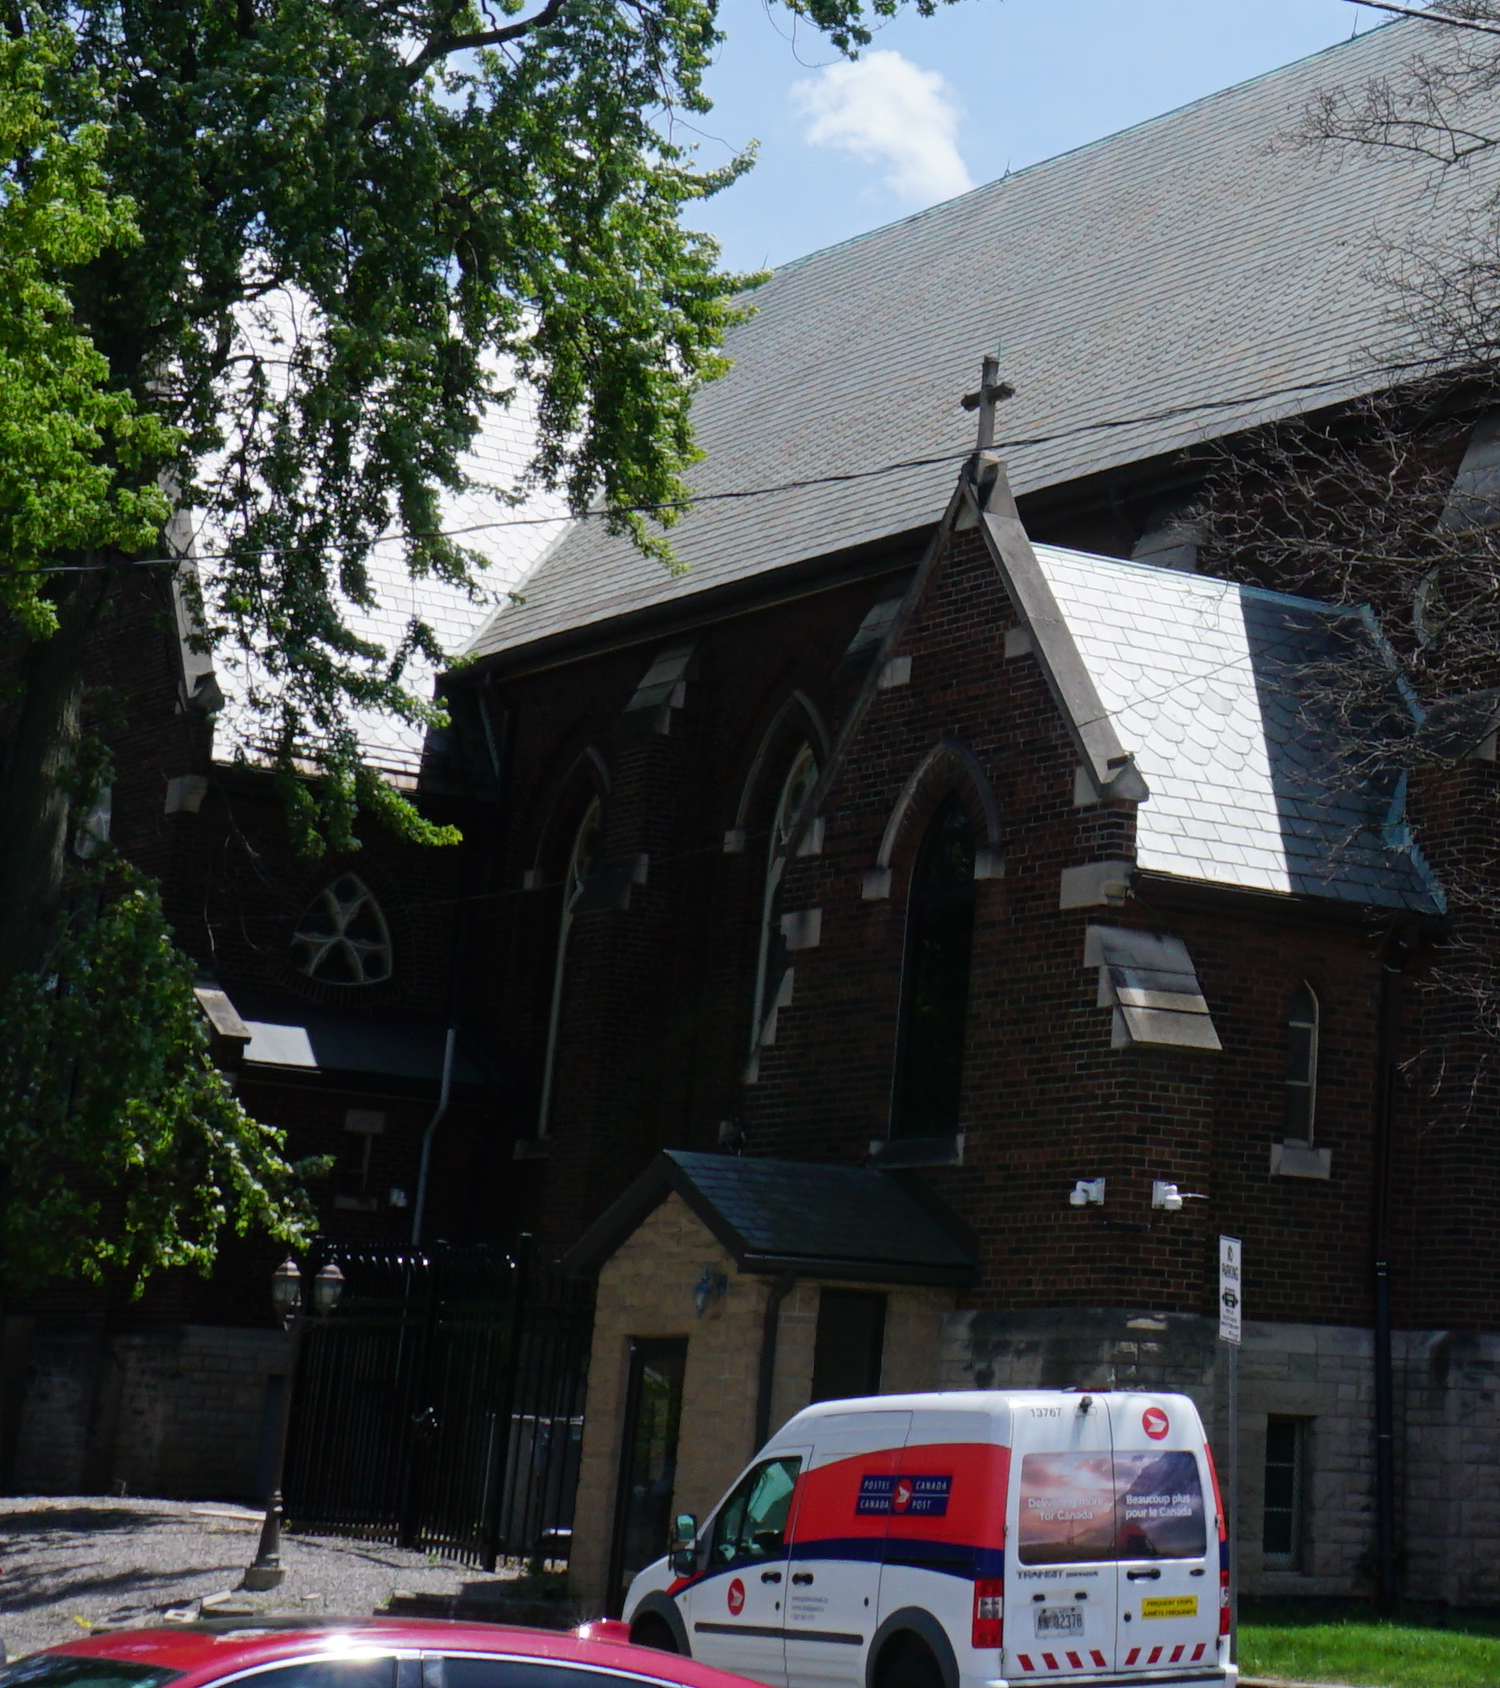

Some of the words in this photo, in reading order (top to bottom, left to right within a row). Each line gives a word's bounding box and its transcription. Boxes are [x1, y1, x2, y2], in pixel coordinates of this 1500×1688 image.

[863, 1480, 890, 1490] POSTES
[915, 1481, 947, 1490] CANADA
[860, 1499, 889, 1508] CANADA
[912, 1500, 931, 1509] POST
[1125, 1494, 1170, 1506] Beaucoup
[1172, 1493, 1191, 1504] plus
[1040, 1511, 1054, 1521] for
[1057, 1511, 1093, 1520] Canada
[1125, 1509, 1148, 1520] pour
[1149, 1507, 1157, 1517] le
[1159, 1506, 1192, 1517] Canada
